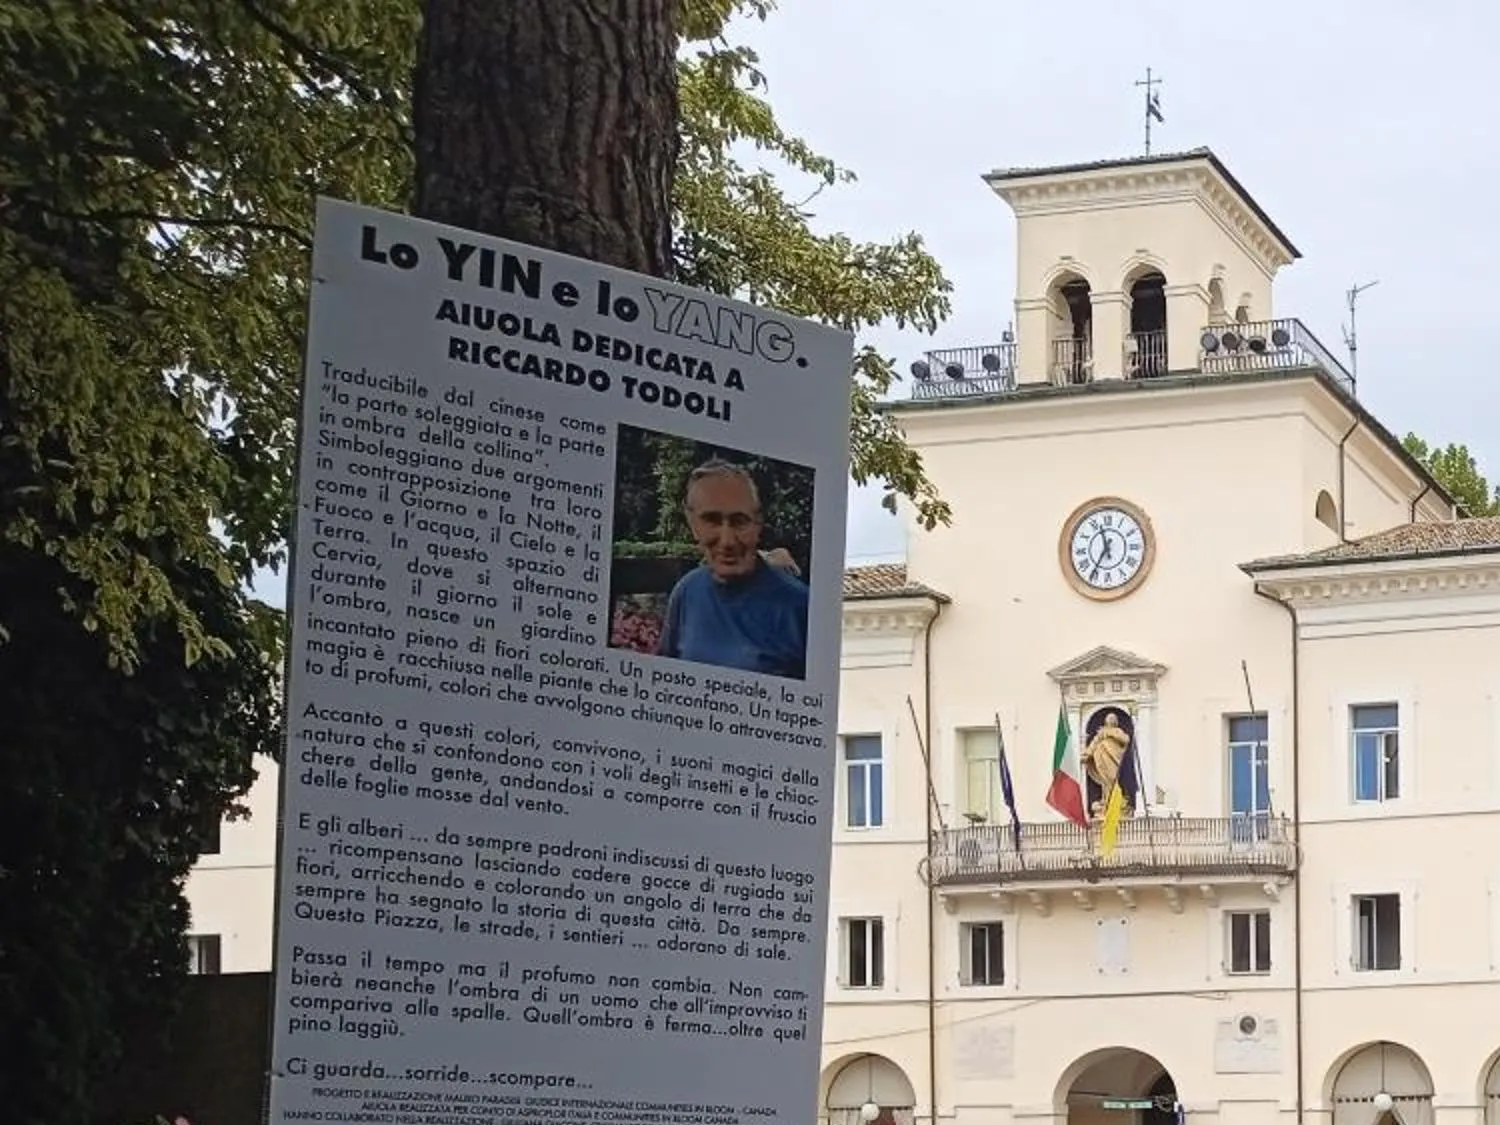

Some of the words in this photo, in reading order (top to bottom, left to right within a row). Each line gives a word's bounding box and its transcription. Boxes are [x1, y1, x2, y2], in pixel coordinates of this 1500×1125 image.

[360, 224, 419, 270] Lo
[436, 236, 541, 299] YIN
[551, 281, 580, 307] e
[596, 279, 640, 322] lo
[642, 285, 809, 368] YANG.
[434, 298, 561, 347] AIUOLA
[571, 328, 716, 384] DEDICATA
[723, 367, 744, 391] A
[320, 360, 428, 398] Traducibile
[443, 386, 474, 408] dal
[488, 397, 545, 423] cinese
[558, 416, 606, 436] come
[447, 335, 611, 392] RICCARDO
[620, 374, 731, 422] TODOLI
[318, 405, 336, 425] in
[341, 410, 405, 439] ombra
[417, 425, 465, 450] della
[355, 395, 408, 416] parte
[414, 404, 512, 442] soleggiata
[517, 428, 529, 441] e
[535, 426, 552, 446] la
[558, 436, 605, 457] parte
[316, 450, 333, 470] in
[347, 461, 511, 509] contrapposizione
[530, 492, 555, 511] tra
[566, 498, 603, 520] loro
[317, 428, 463, 471] Simboleggiano
[470, 458, 505, 480] due
[512, 470, 603, 500] argomenti
[311, 540, 382, 571] Cervia,
[406, 555, 453, 579] dove
[476, 568, 490, 586] si
[512, 575, 599, 604] alternano
[312, 517, 370, 544] Terra.
[390, 531, 408, 549] In
[425, 538, 488, 563] questo
[505, 556, 566, 577] spazio
[582, 564, 600, 583] di
[309, 583, 391, 616] l'ombra,
[405, 604, 460, 624] nasce
[472, 615, 495, 630] un
[520, 620, 597, 646] giardino
[310, 562, 386, 591] durante
[411, 578, 422, 597] il
[435, 584, 497, 609] giorno
[512, 595, 523, 612] il
[536, 602, 573, 621] sole
[585, 612, 597, 625] e
[307, 611, 395, 641] incantato
[405, 627, 458, 653] pieno
[467, 635, 485, 654] di
[494, 638, 530, 661] fiori
[538, 648, 609, 673] colorati.
[619, 659, 643, 679] Un
[650, 669, 696, 687] posto
[704, 678, 771, 702] speciale,
[780, 684, 795, 704] la
[801, 692, 823, 708] cui
[304, 658, 324, 675] to
[330, 658, 348, 678] di
[354, 666, 432, 692] profumi,
[438, 676, 491, 698] colori
[496, 683, 528, 703] che
[533, 694, 625, 717] avvolgono
[630, 703, 704, 731] chiunque
[708, 714, 724, 733] lo
[302, 701, 383, 727] Accanto
[394, 718, 407, 730] a
[418, 720, 473, 745] questi
[483, 726, 540, 751] colori,
[551, 738, 646, 766] convivono,
[655, 747, 661, 764] i
[670, 754, 713, 771] suoni
[721, 762, 773, 783] magici
[780, 766, 819, 787] della
[299, 766, 348, 789] delle
[354, 771, 409, 798] foglie
[414, 785, 473, 803] mosse
[478, 787, 509, 808] dal
[514, 797, 569, 815] vento.
[300, 744, 355, 768] chere
[368, 752, 417, 775] della
[430, 766, 488, 786] gente,
[498, 771, 594, 797] andandosi
[602, 787, 614, 799] a
[623, 790, 704, 811] comporre
[712, 801, 741, 816] con
[750, 801, 760, 819] il
[767, 802, 817, 826] fruscio
[295, 854, 340, 880] fiori,
[350, 864, 465, 889] arricchendo
[473, 878, 485, 891] e
[493, 876, 586, 901] colorando
[593, 890, 615, 904] un
[622, 889, 682, 913] angolo
[688, 895, 705, 912] di
[712, 899, 751, 917] terra
[757, 902, 785, 921] che
[791, 905, 812, 923] da
[328, 838, 463, 872] ricompensano
[474, 851, 561, 877] lasciando
[571, 864, 631, 885] cadere
[640, 874, 691, 894] gocce
[698, 876, 715, 893] di
[723, 882, 785, 905] rugiada
[792, 888, 813, 904] sui
[287, 1012, 333, 1035] pino
[337, 1013, 405, 1040] laggiù.
[289, 995, 393, 1016] compariva
[404, 997, 439, 1016] alle
[451, 1001, 510, 1023] spalle.
[522, 1005, 633, 1029] Quell'ombra
[643, 1013, 654, 1031] è
[772, 1024, 806, 1044] quel
[290, 966, 342, 988] bierà
[354, 975, 435, 995] neanche
[447, 977, 519, 1001] l'ombra
[530, 984, 548, 1002] di
[558, 992, 579, 1005] un
[590, 994, 639, 1009] uomo
[648, 993, 678, 1012] che
[797, 1005, 807, 1021] ti
[285, 1056, 307, 1075] Ci
